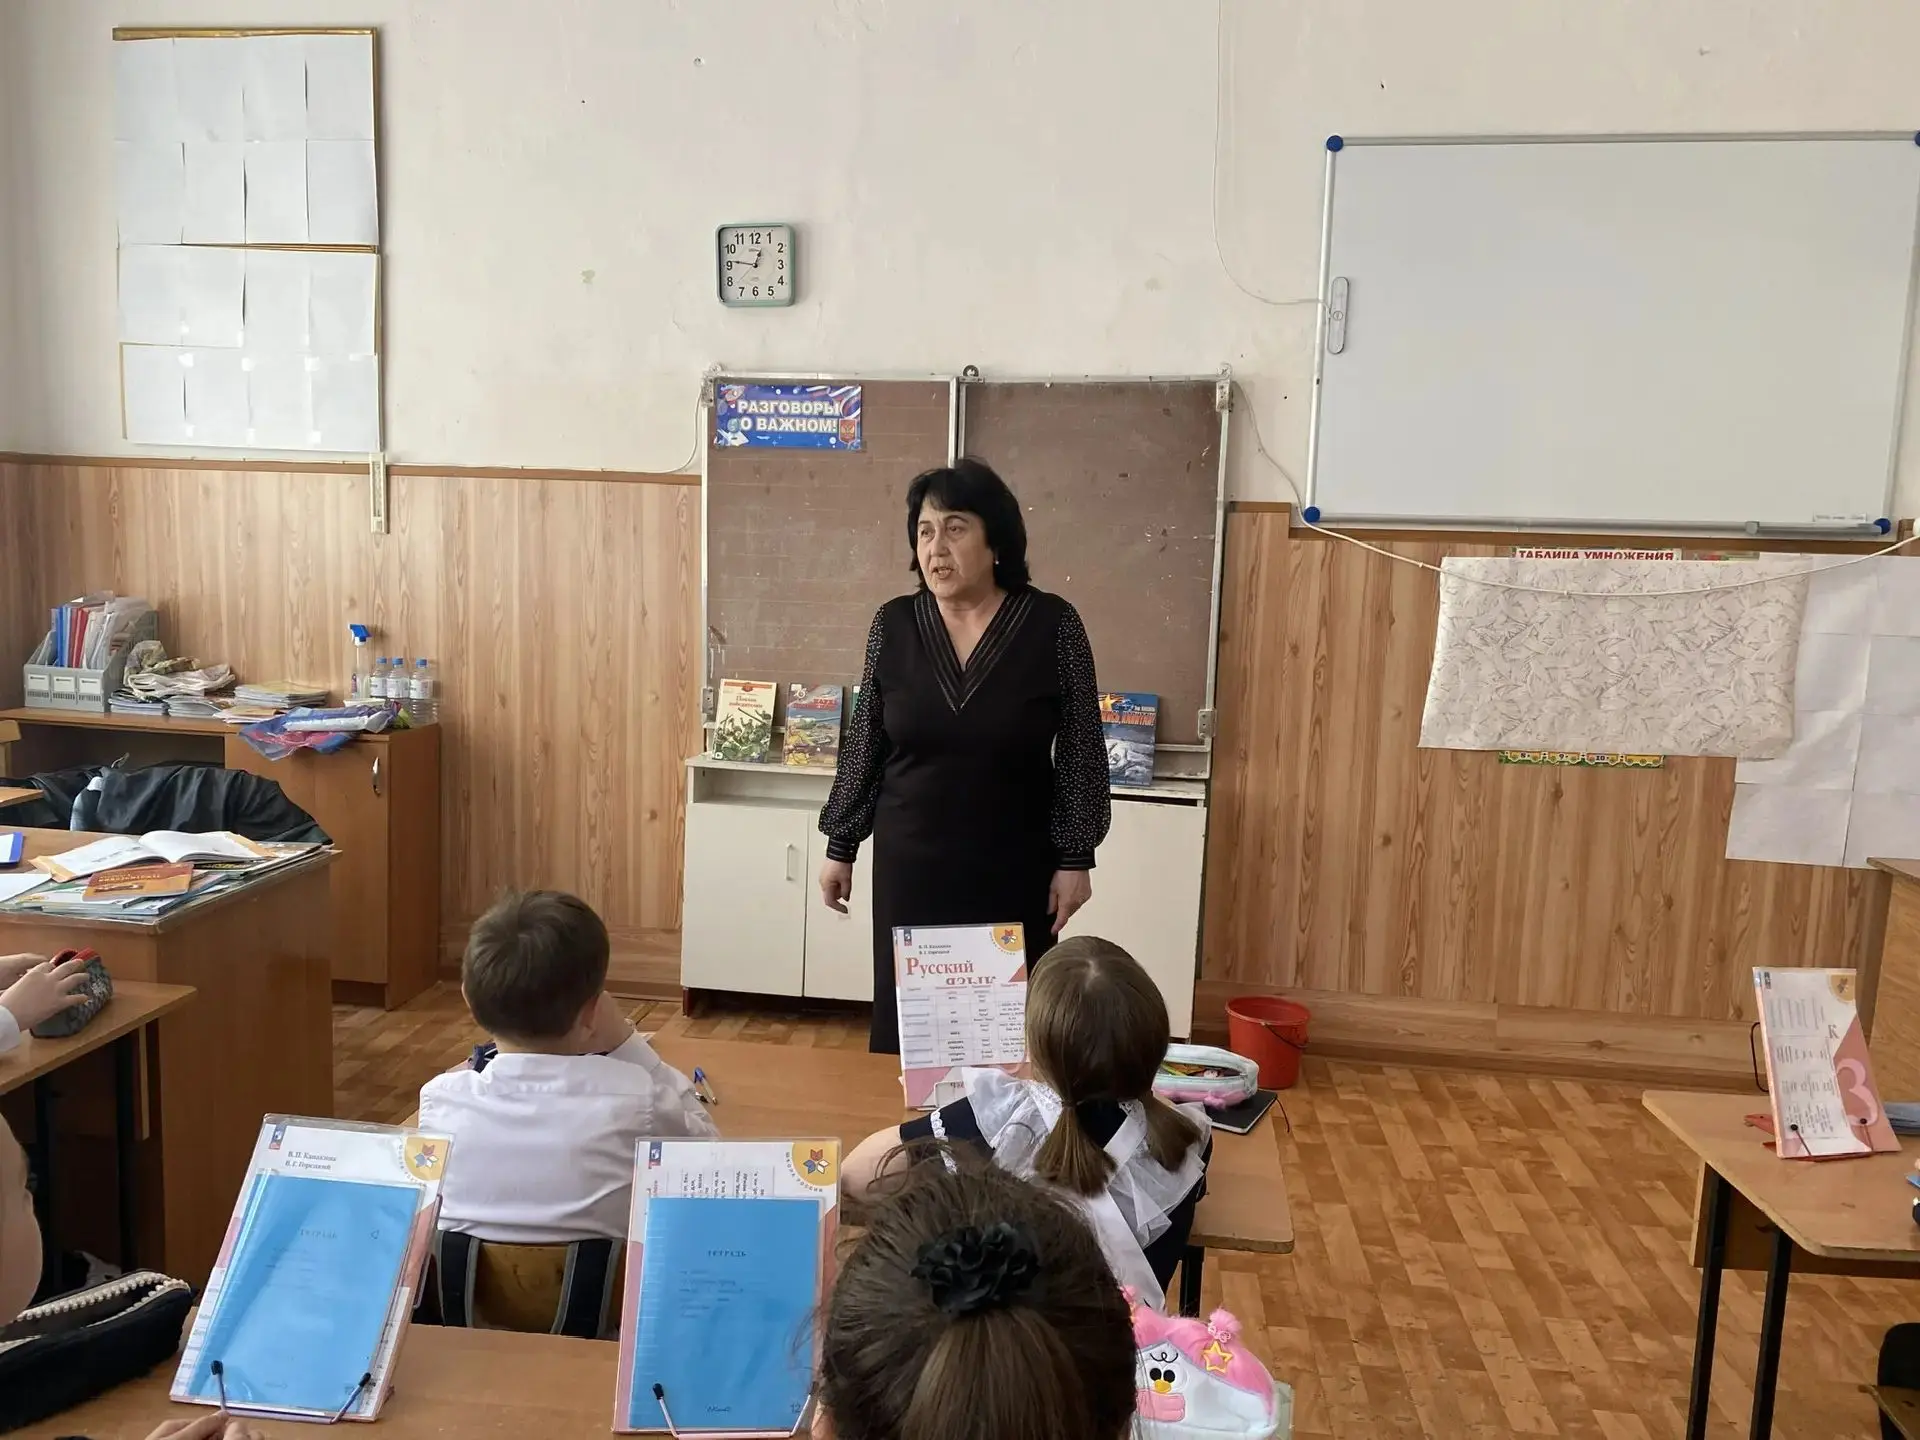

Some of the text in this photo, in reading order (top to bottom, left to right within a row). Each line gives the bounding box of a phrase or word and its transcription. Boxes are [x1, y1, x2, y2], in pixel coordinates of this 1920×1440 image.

[734, 232, 745, 245] 11
[748, 232, 761, 245] 12
[766, 232, 772, 244] 1
[725, 243, 736, 254] 10
[777, 242, 784, 253] 2
[726, 260, 733, 271] 9
[777, 259, 784, 270] 3
[726, 276, 733, 287] 8
[777, 275, 784, 286] 4
[738, 286, 745, 297] 7
[752, 286, 759, 297] 6
[767, 286, 774, 296] 5
[737, 400, 840, 416] РАЗГОВОРЫ
[740, 417, 837, 433] О ВАЖНОМ!
[1519, 550, 1675, 561] ТАБЛИЦА УМНОЖЕНИЯ
[905, 957, 974, 979] Русский
